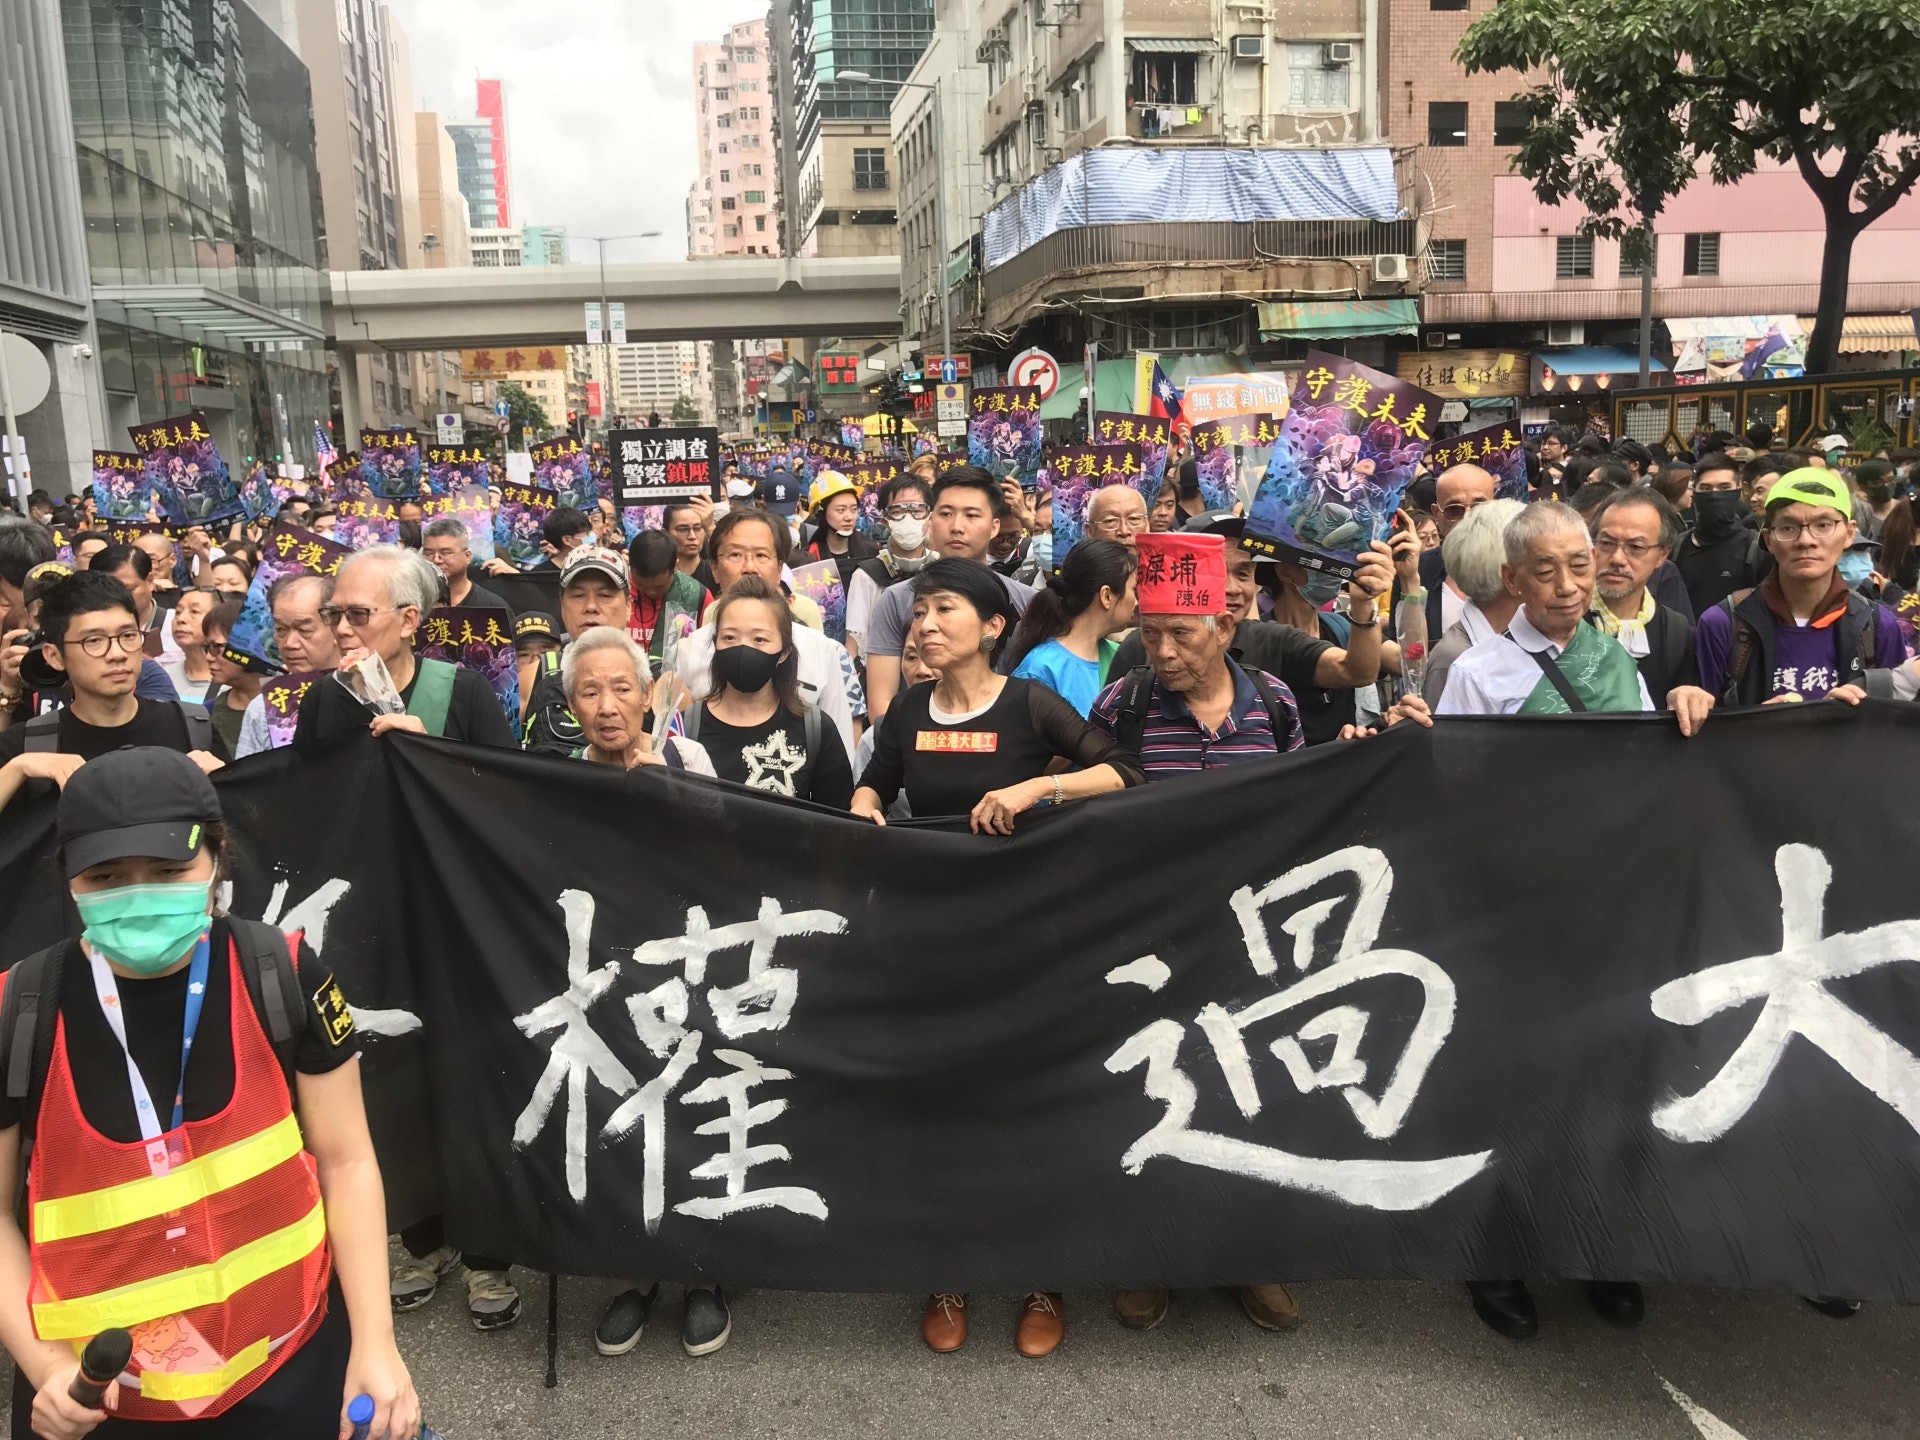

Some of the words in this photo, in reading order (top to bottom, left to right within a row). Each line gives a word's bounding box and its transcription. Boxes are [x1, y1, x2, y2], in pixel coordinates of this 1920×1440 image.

[973, 392, 1041, 413] 守護未來
[1192, 386, 1283, 411] 無綫新聞
[1306, 366, 1430, 441] 守護未來
[135, 420, 211, 451] 守護未來
[362, 432, 418, 448] 守護未來
[1100, 419, 1169, 445] 守護未來
[1195, 420, 1274, 452] 守護未來
[429, 448, 486, 464] 守護未來
[532, 439, 583, 463] 守護未來
[620, 438, 709, 463] 獨立調查
[810, 443, 852, 462] 守護未來
[1435, 429, 1521, 467] 守護未來
[95, 454, 146, 471] 守護未來
[622, 462, 710, 486] 警察鎮壓
[1054, 452, 1141, 477] 守護未來
[423, 495, 490, 516] 守護未來
[504, 487, 556, 510] 守護未來
[338, 501, 400, 521] 守護未來
[276, 533, 345, 577] 守護未
[1176, 590, 1209, 606] 陳伯
